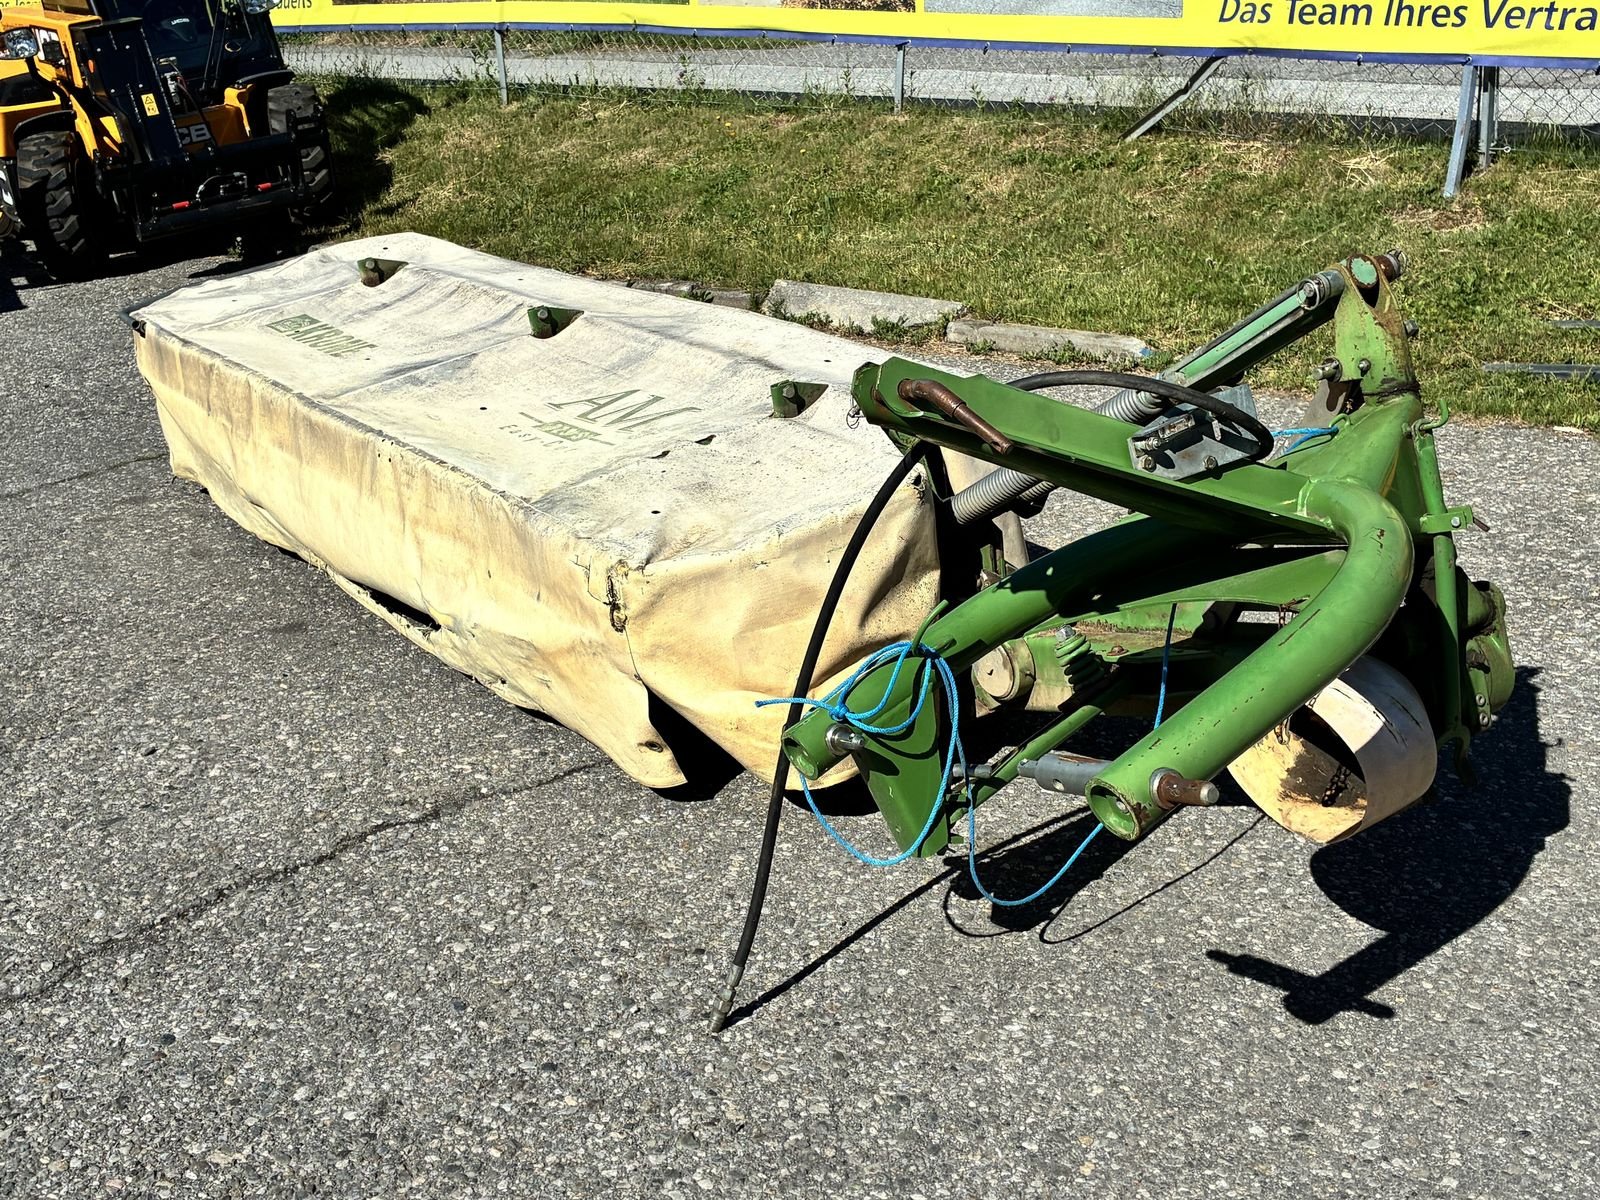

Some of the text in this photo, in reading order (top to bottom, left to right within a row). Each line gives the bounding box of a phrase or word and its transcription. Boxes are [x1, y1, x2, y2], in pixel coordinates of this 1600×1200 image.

[1218, 0, 1598, 31] Das Team Ihres Vertra
[178, 124, 211, 144] CB
[285, 323, 378, 357] KRONE
[543, 388, 702, 432] AM
